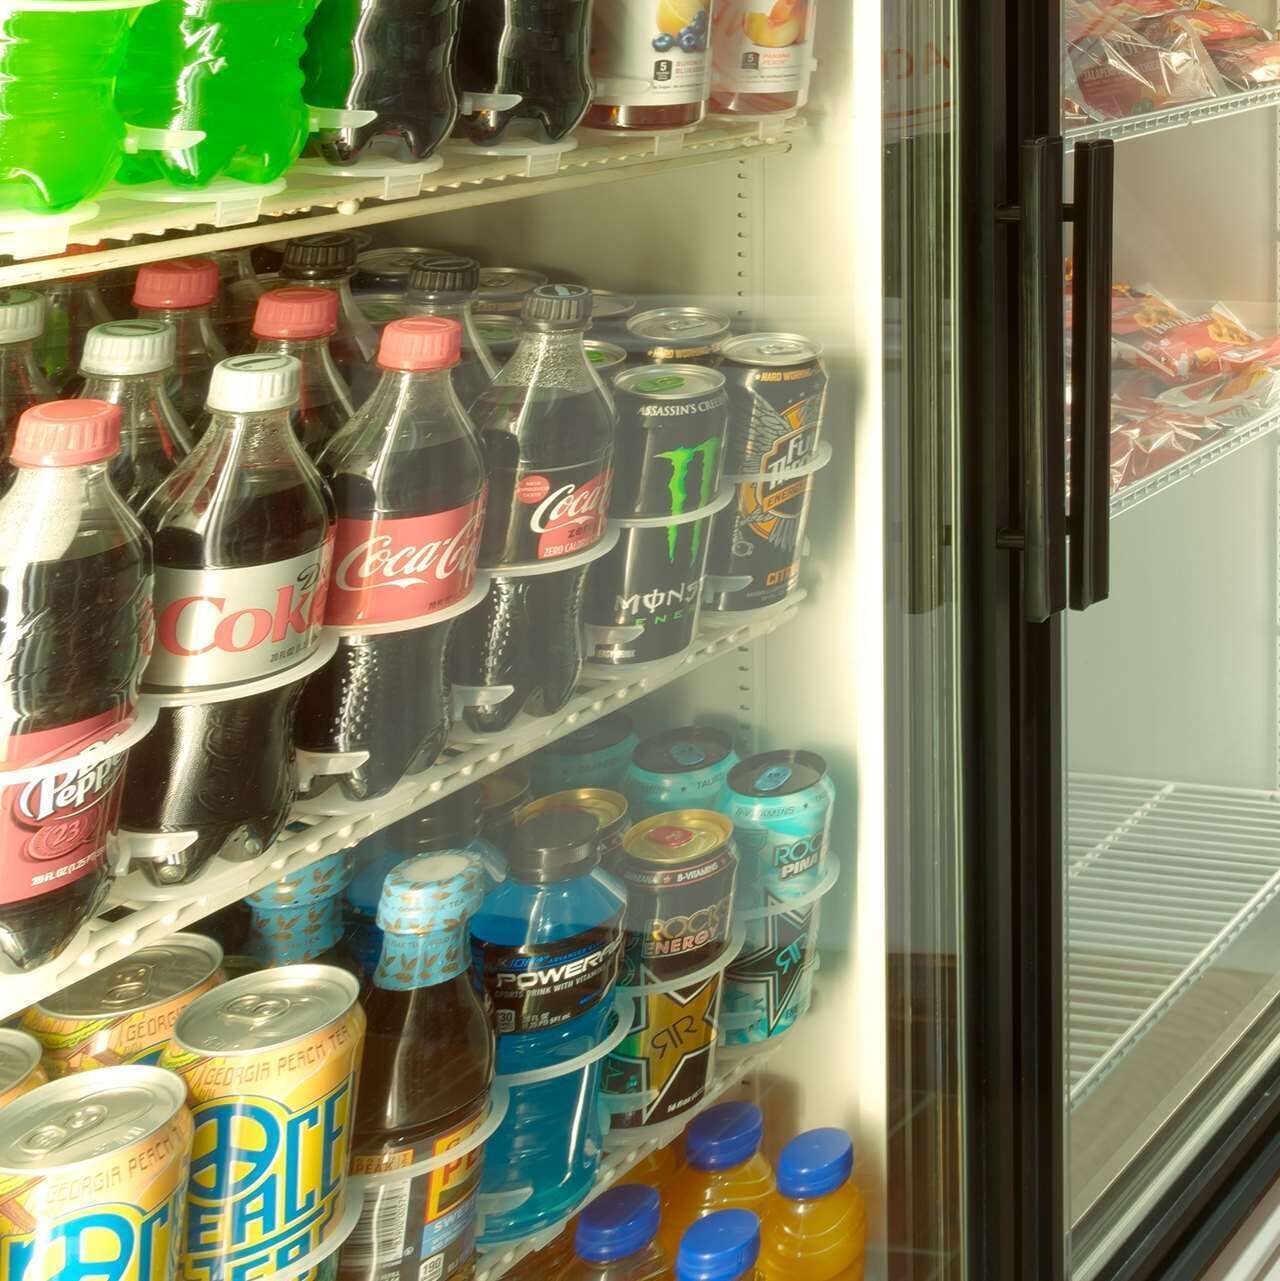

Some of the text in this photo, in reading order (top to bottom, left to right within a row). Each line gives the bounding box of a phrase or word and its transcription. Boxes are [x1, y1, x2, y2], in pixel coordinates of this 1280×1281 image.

[637, 402, 698, 417] ASSASSIN'S
[543, 543, 564, 558] ZERO
[158, 584, 325, 658] Cok
[53, 819, 81, 848] 23
[644, 926, 717, 957] ENERGY
[526, 986, 552, 998] DRINK
[553, 980, 574, 993] WITH
[203, 1061, 271, 1088] GEORGIA
[277, 1039, 325, 1076] PEACH
[127, 1139, 172, 1181] PEACH
